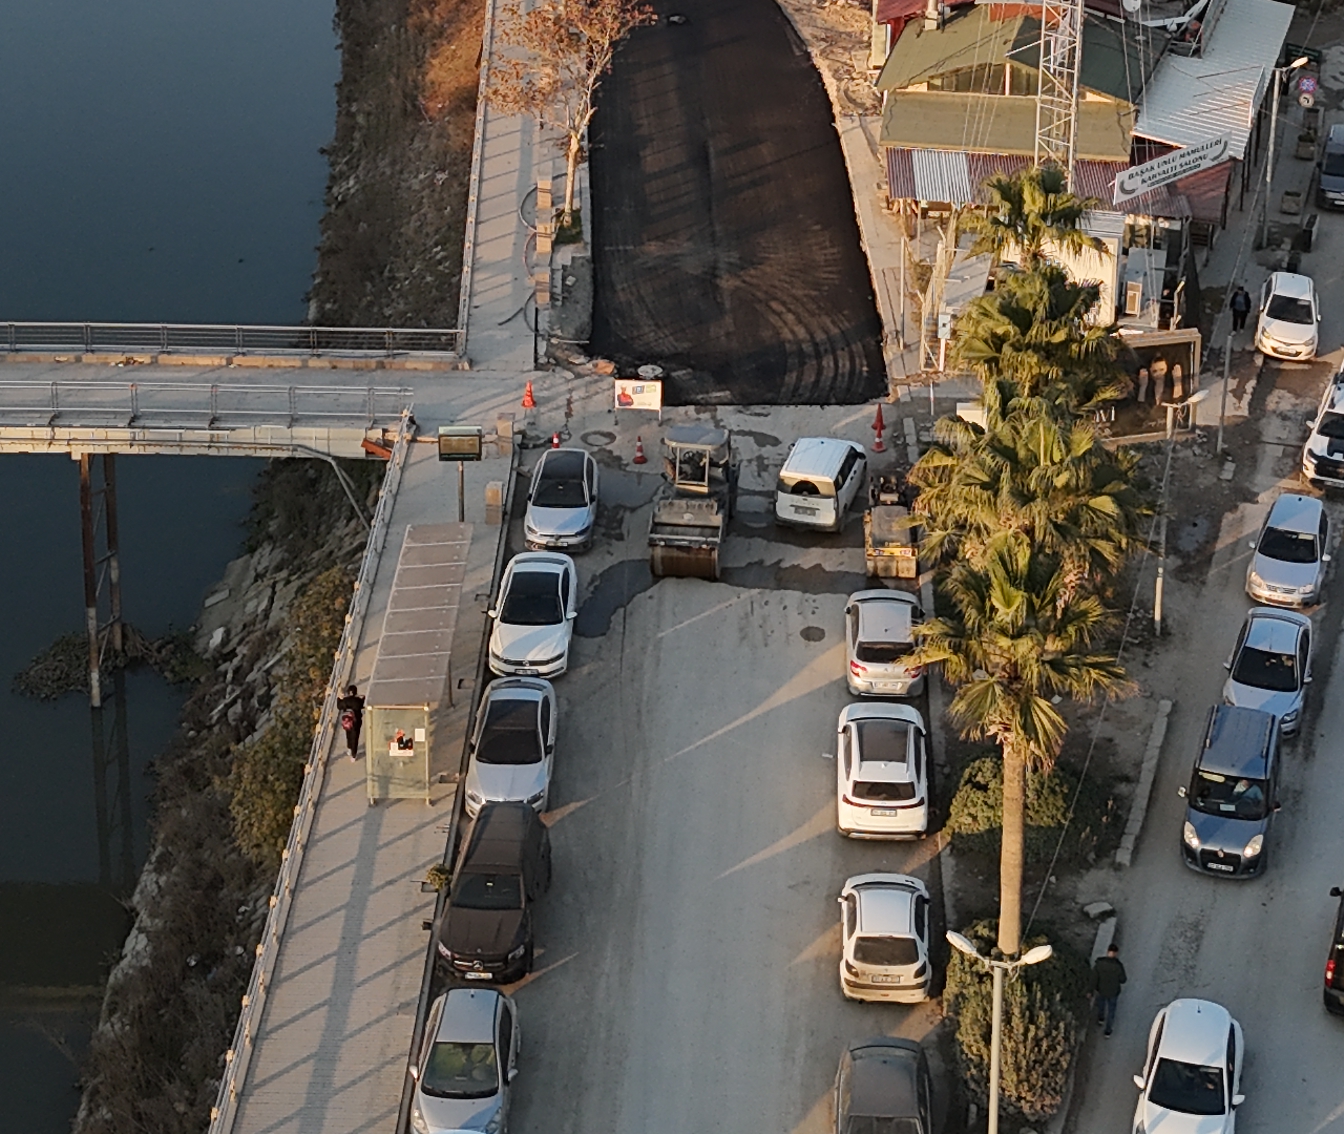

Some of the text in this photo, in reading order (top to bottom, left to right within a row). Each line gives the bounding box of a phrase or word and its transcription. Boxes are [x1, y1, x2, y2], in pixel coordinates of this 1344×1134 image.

[1128, 165, 1155, 181] BAŞAK
[1140, 166, 1177, 185] KAHVALTI
[1179, 153, 1209, 169] SALONU
